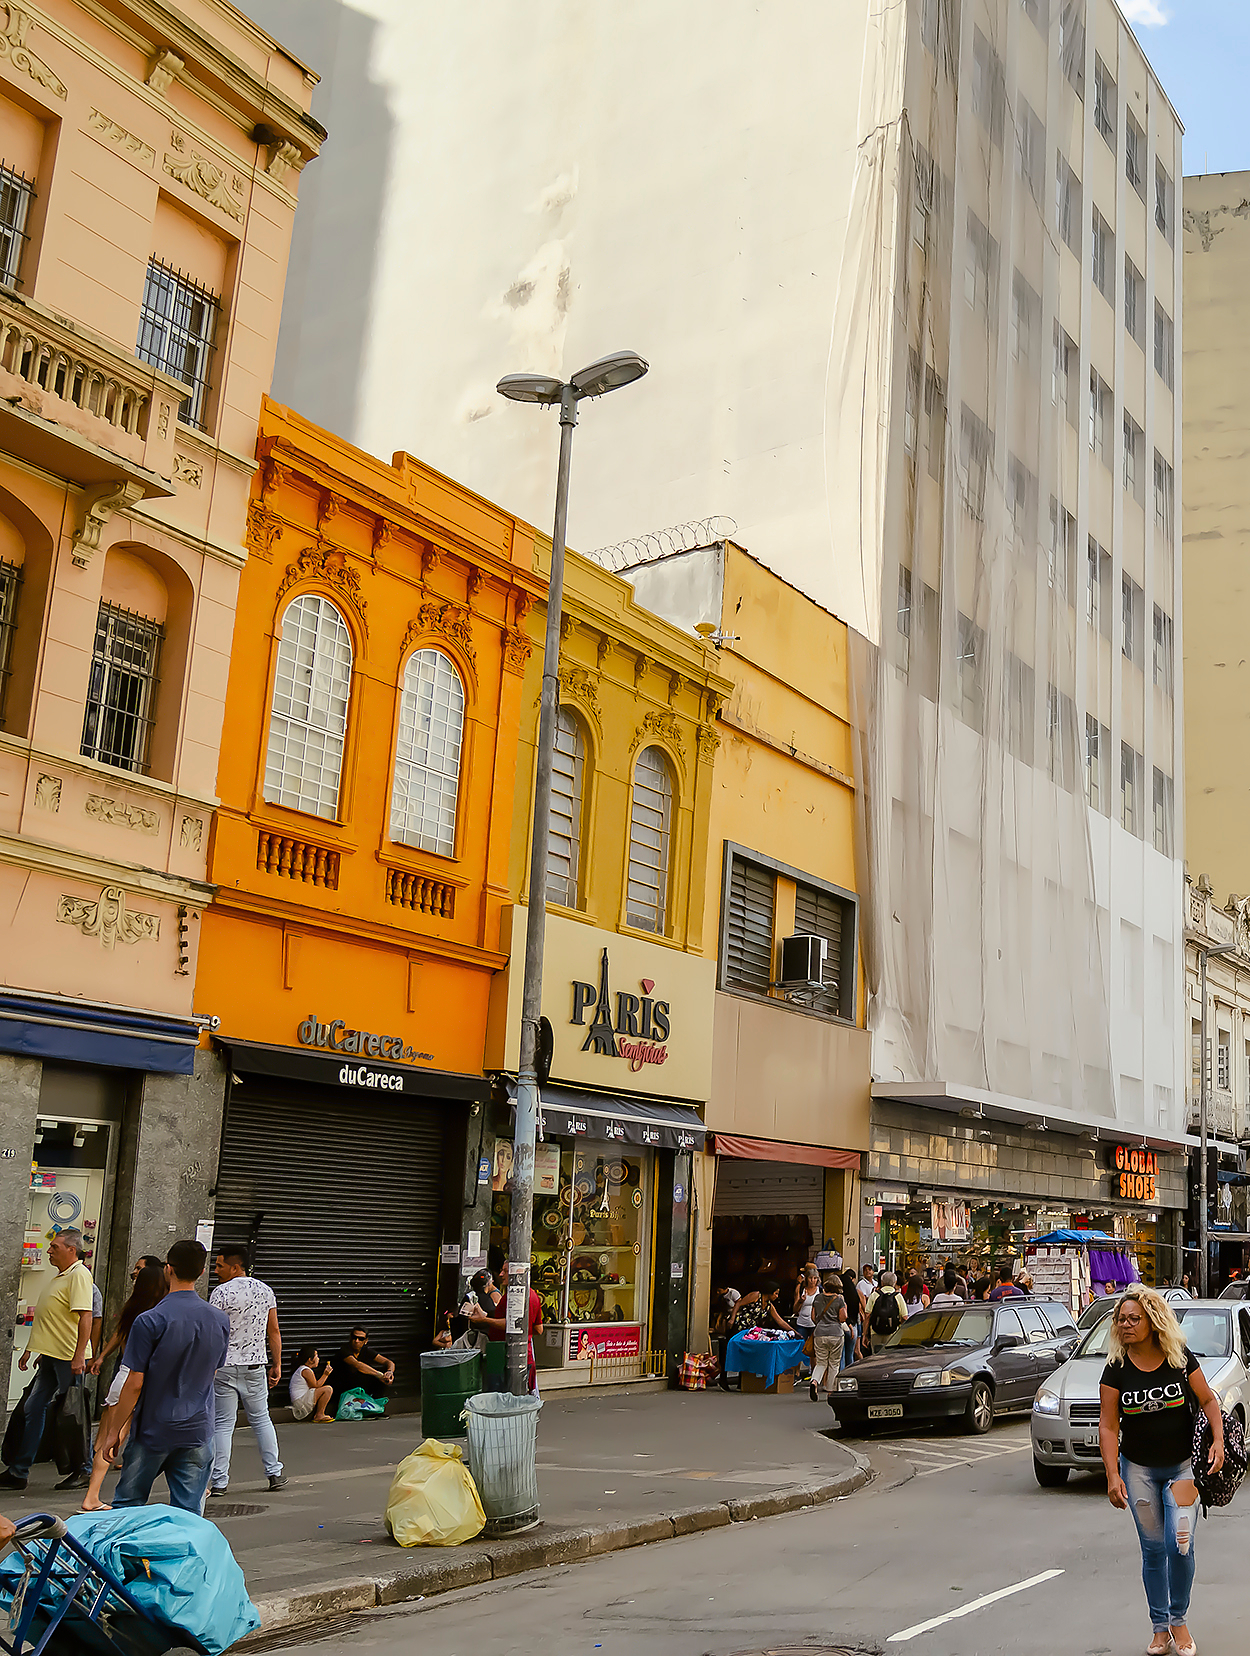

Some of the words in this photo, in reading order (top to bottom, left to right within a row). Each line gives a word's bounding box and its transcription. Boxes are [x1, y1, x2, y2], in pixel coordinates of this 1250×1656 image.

[568, 947, 671, 1057] PARIS
[297, 1014, 404, 1060] duCareca
[338, 1064, 404, 1091] duCareca
[567, 1115, 587, 1134] PARIS
[605, 1120, 625, 1138] PARIS
[642, 1125, 660, 1143] PARIS
[678, 1130, 695, 1148] PARIS
[1115, 1145, 1160, 1175] GLOBAL
[1119, 1172, 1156, 1200] SHOES
[1121, 1382, 1183, 1406] GUCCI
